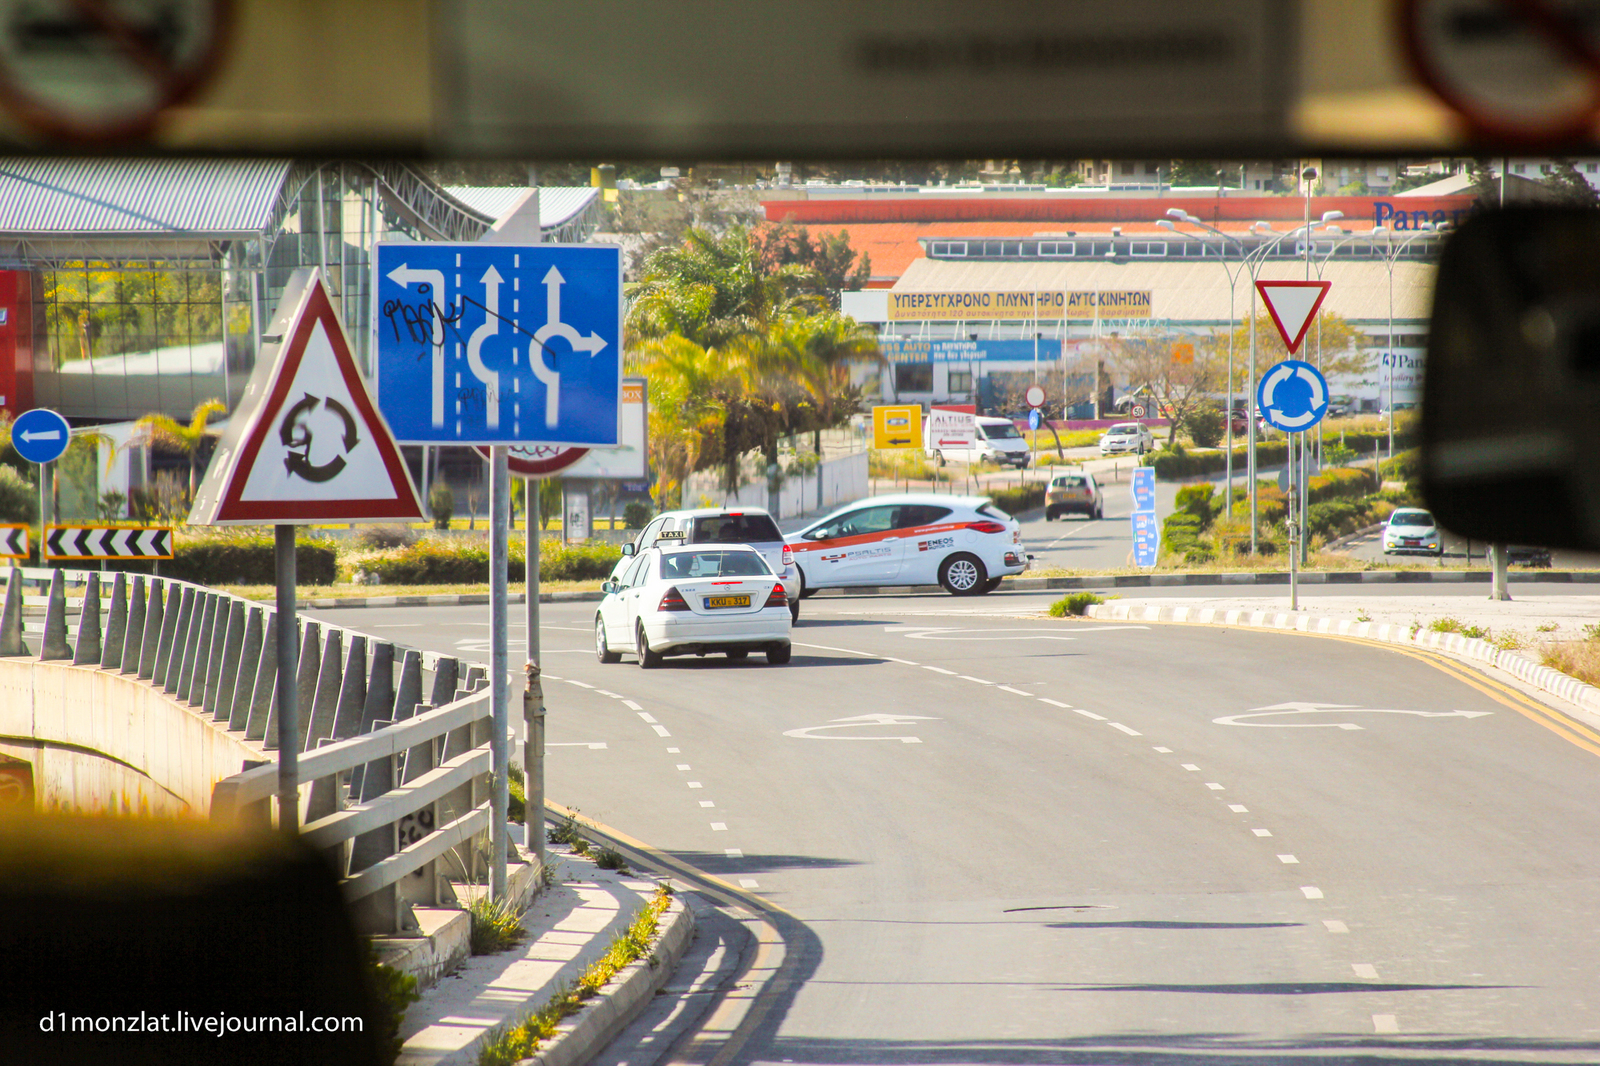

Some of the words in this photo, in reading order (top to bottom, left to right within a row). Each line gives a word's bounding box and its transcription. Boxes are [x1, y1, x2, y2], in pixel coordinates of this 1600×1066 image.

[894, 293, 990, 308] ΥΠΕΡΣΥΓΧΡΟΝΟ
[996, 292, 1064, 307] ΠΛΥΝΤΗΡΙΟ
[1068, 292, 1150, 307] ΑΥΤΟΚΙΝΗΤΩΝ
[903, 342, 931, 352] AUTO
[1134, 407, 1143, 416] 50
[935, 416, 972, 424] ALTIUS
[927, 537, 954, 547] ENEOS
[847, 547, 892, 557] PSALTIS
[711, 598, 727, 606] KKU
[733, 596, 748, 605] 317
